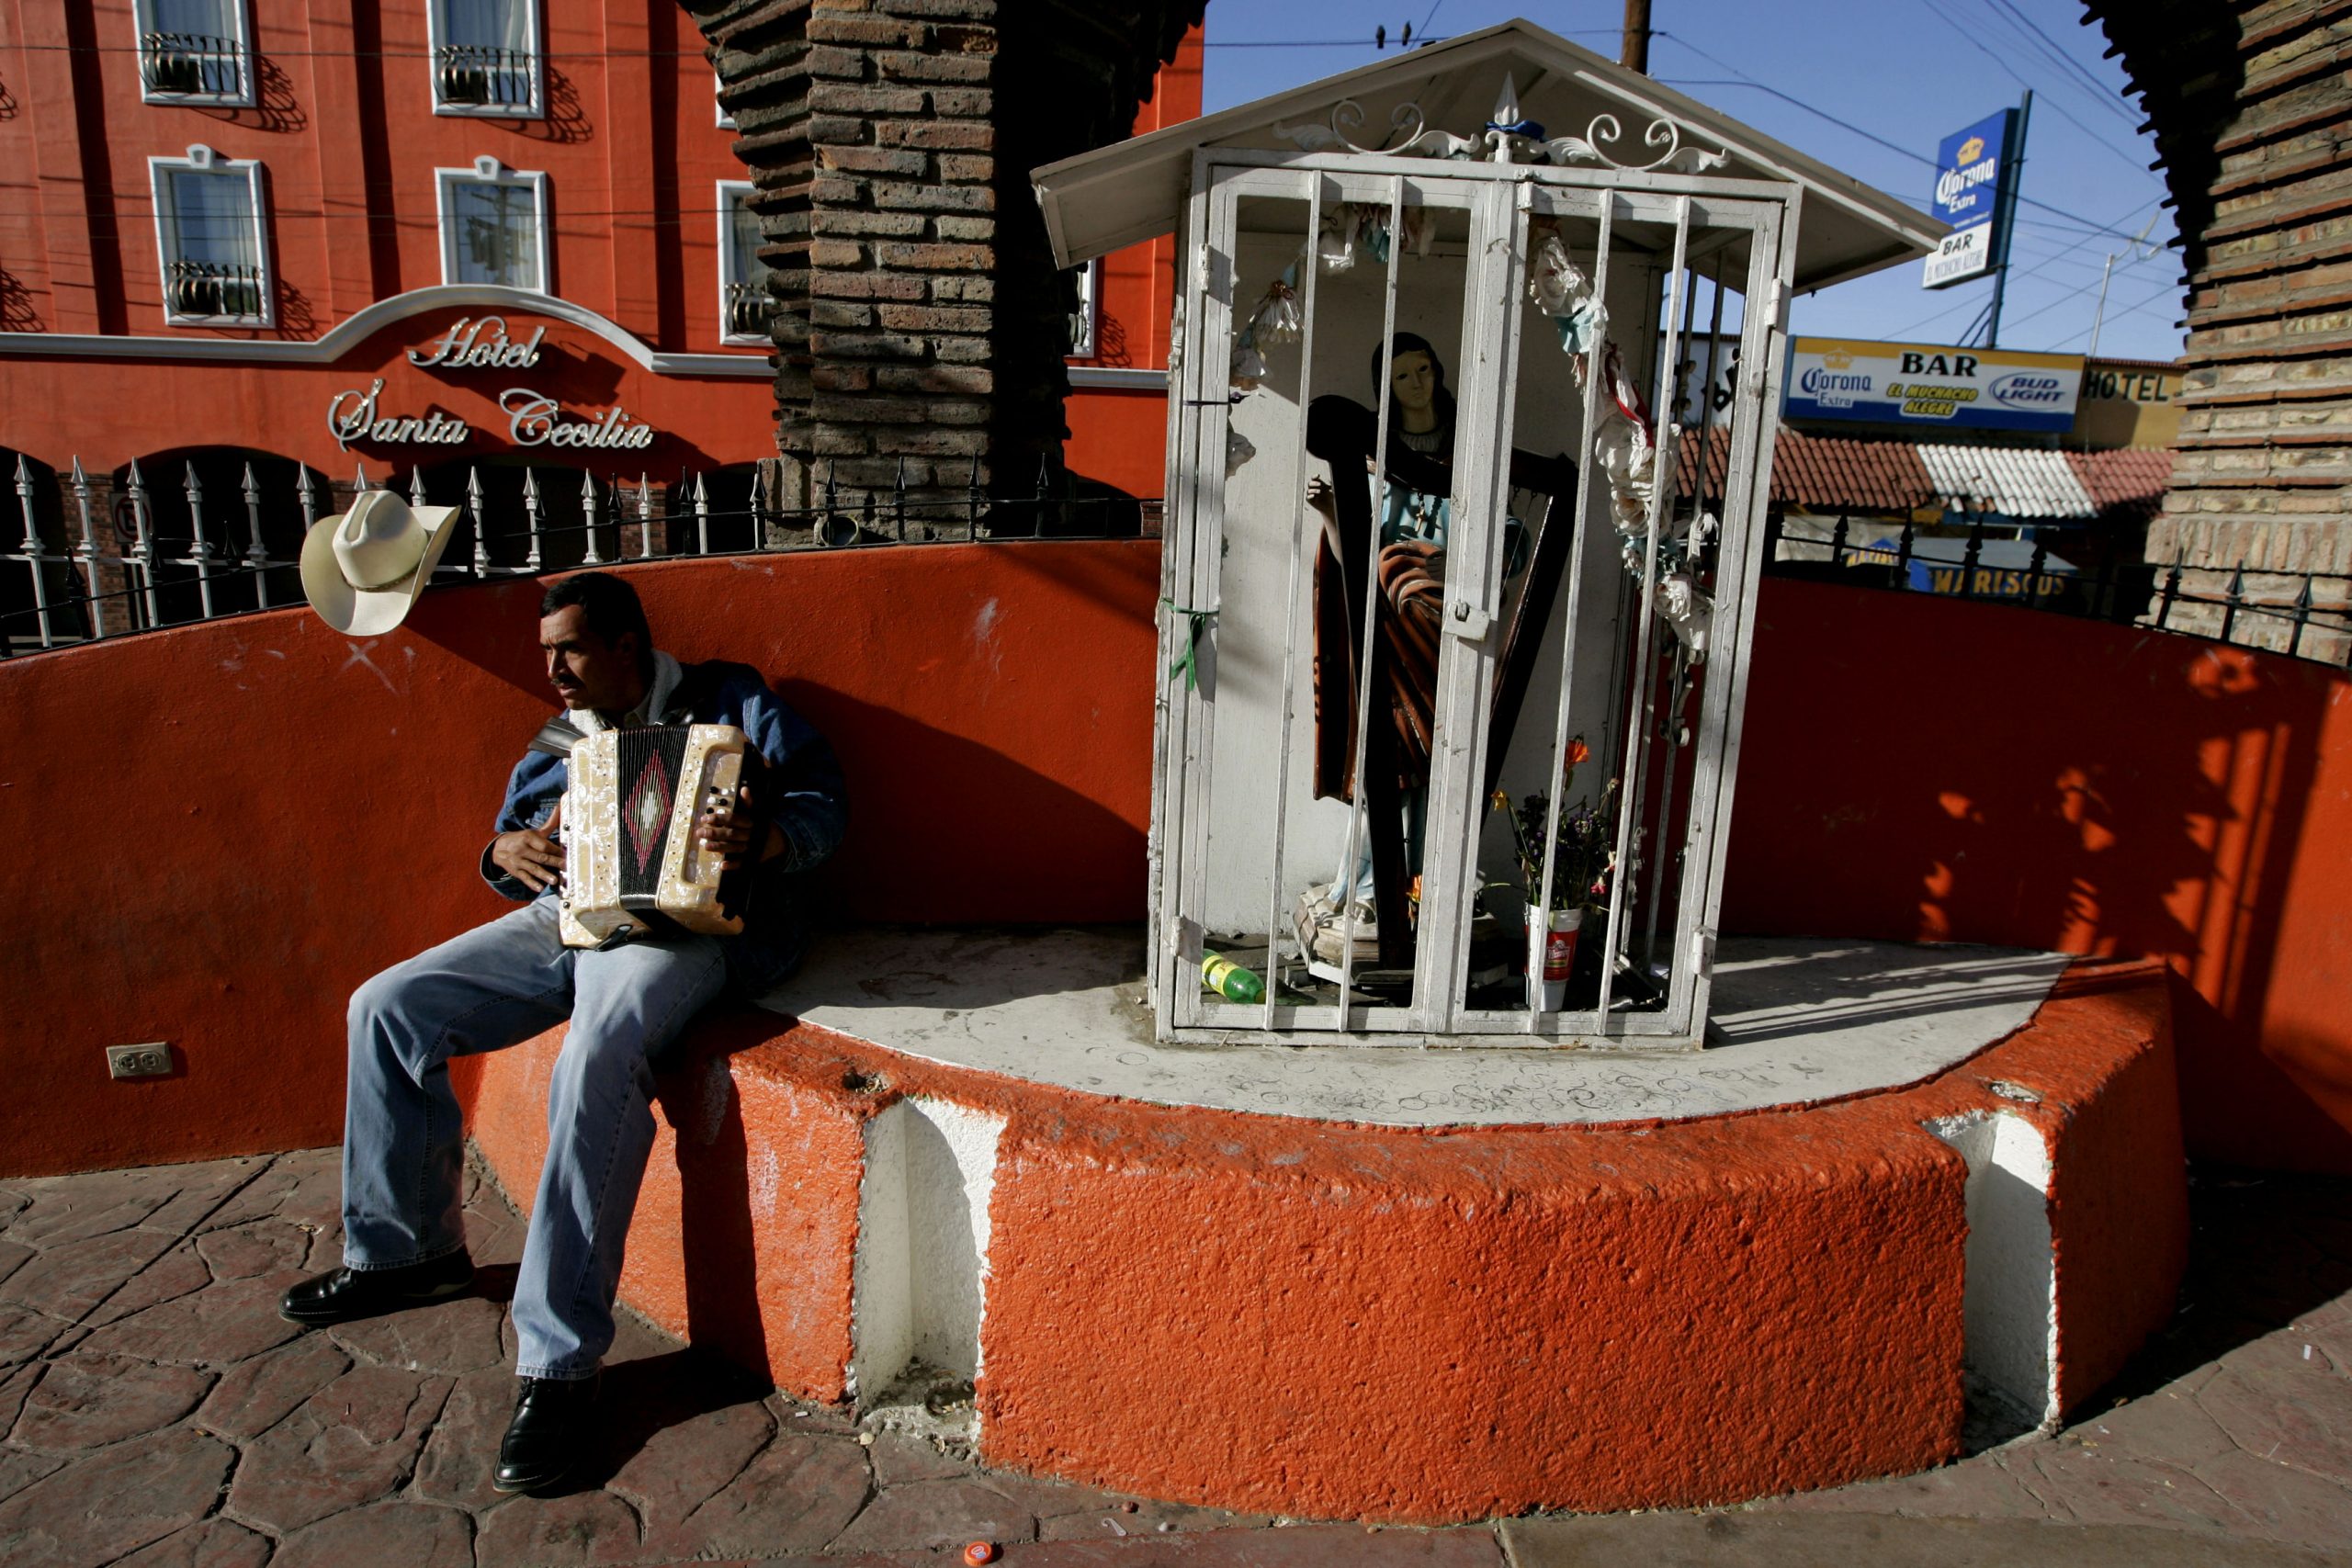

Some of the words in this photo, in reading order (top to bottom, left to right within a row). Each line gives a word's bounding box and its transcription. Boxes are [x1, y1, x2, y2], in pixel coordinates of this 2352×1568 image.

[1936, 157, 1994, 205] Corona
[1949, 194, 1976, 214] Extra
[1942, 233, 1973, 256] BAR
[407, 316, 546, 367] Hotel
[1900, 353, 1977, 378] BAR
[1801, 367, 1871, 395] Corona
[1886, 382, 1904, 398] EL
[1905, 384, 1979, 402] MUCHACHO
[2010, 377, 2059, 389] BUD
[2083, 370, 2168, 401] HOTEL
[1819, 391, 1852, 407] Extra
[1998, 388, 2066, 403] LIGHT
[327, 378, 468, 452] Santa
[499, 388, 653, 448] Cecilia
[1904, 401, 1955, 416] ALEGRE
